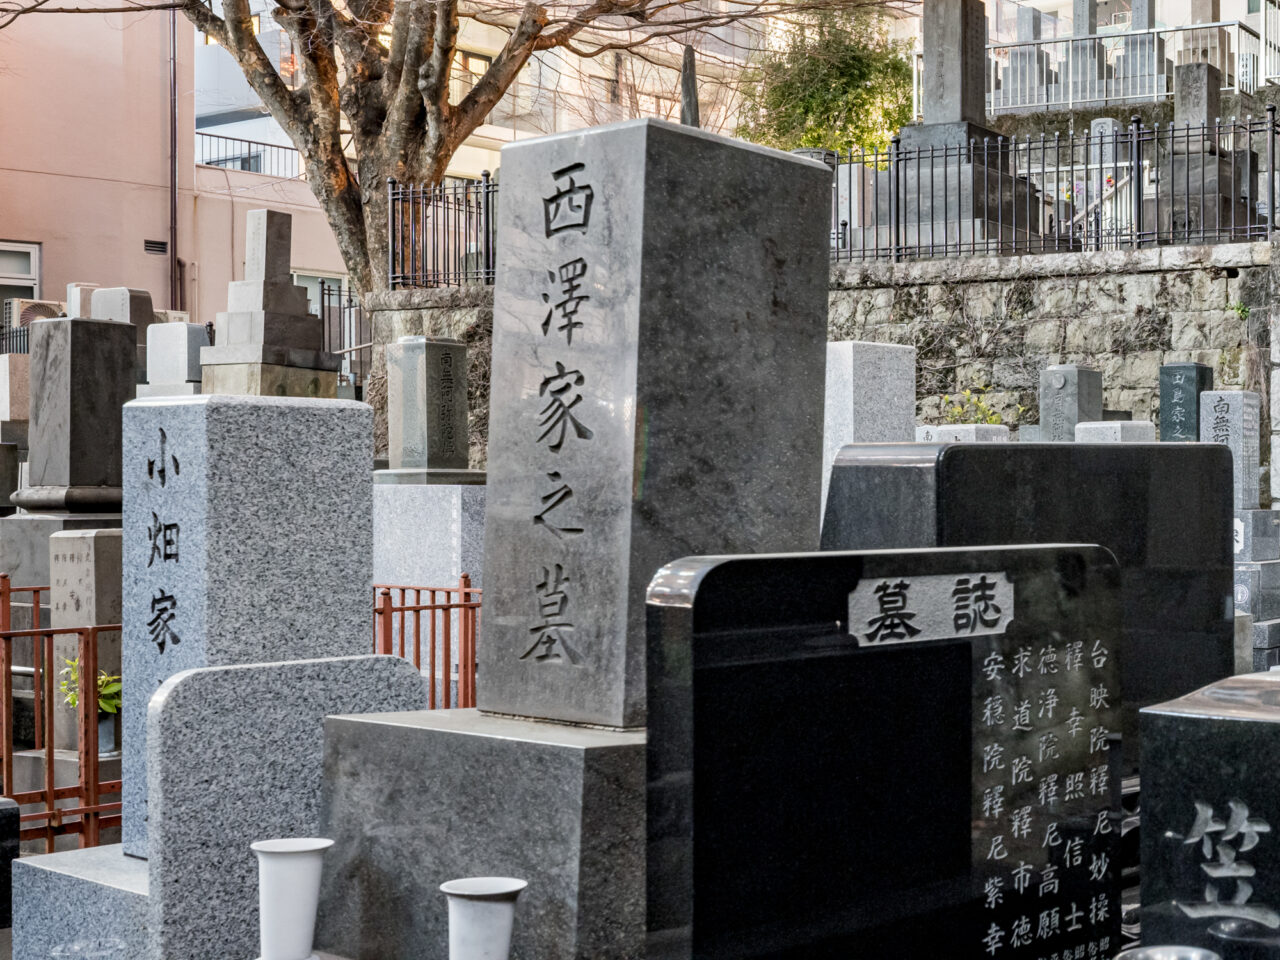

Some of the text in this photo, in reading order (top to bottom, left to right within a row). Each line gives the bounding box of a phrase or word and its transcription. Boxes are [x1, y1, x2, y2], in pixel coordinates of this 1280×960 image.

[519, 161, 595, 667] 西澤家之墓
[865, 575, 1004, 643] 墓誌
